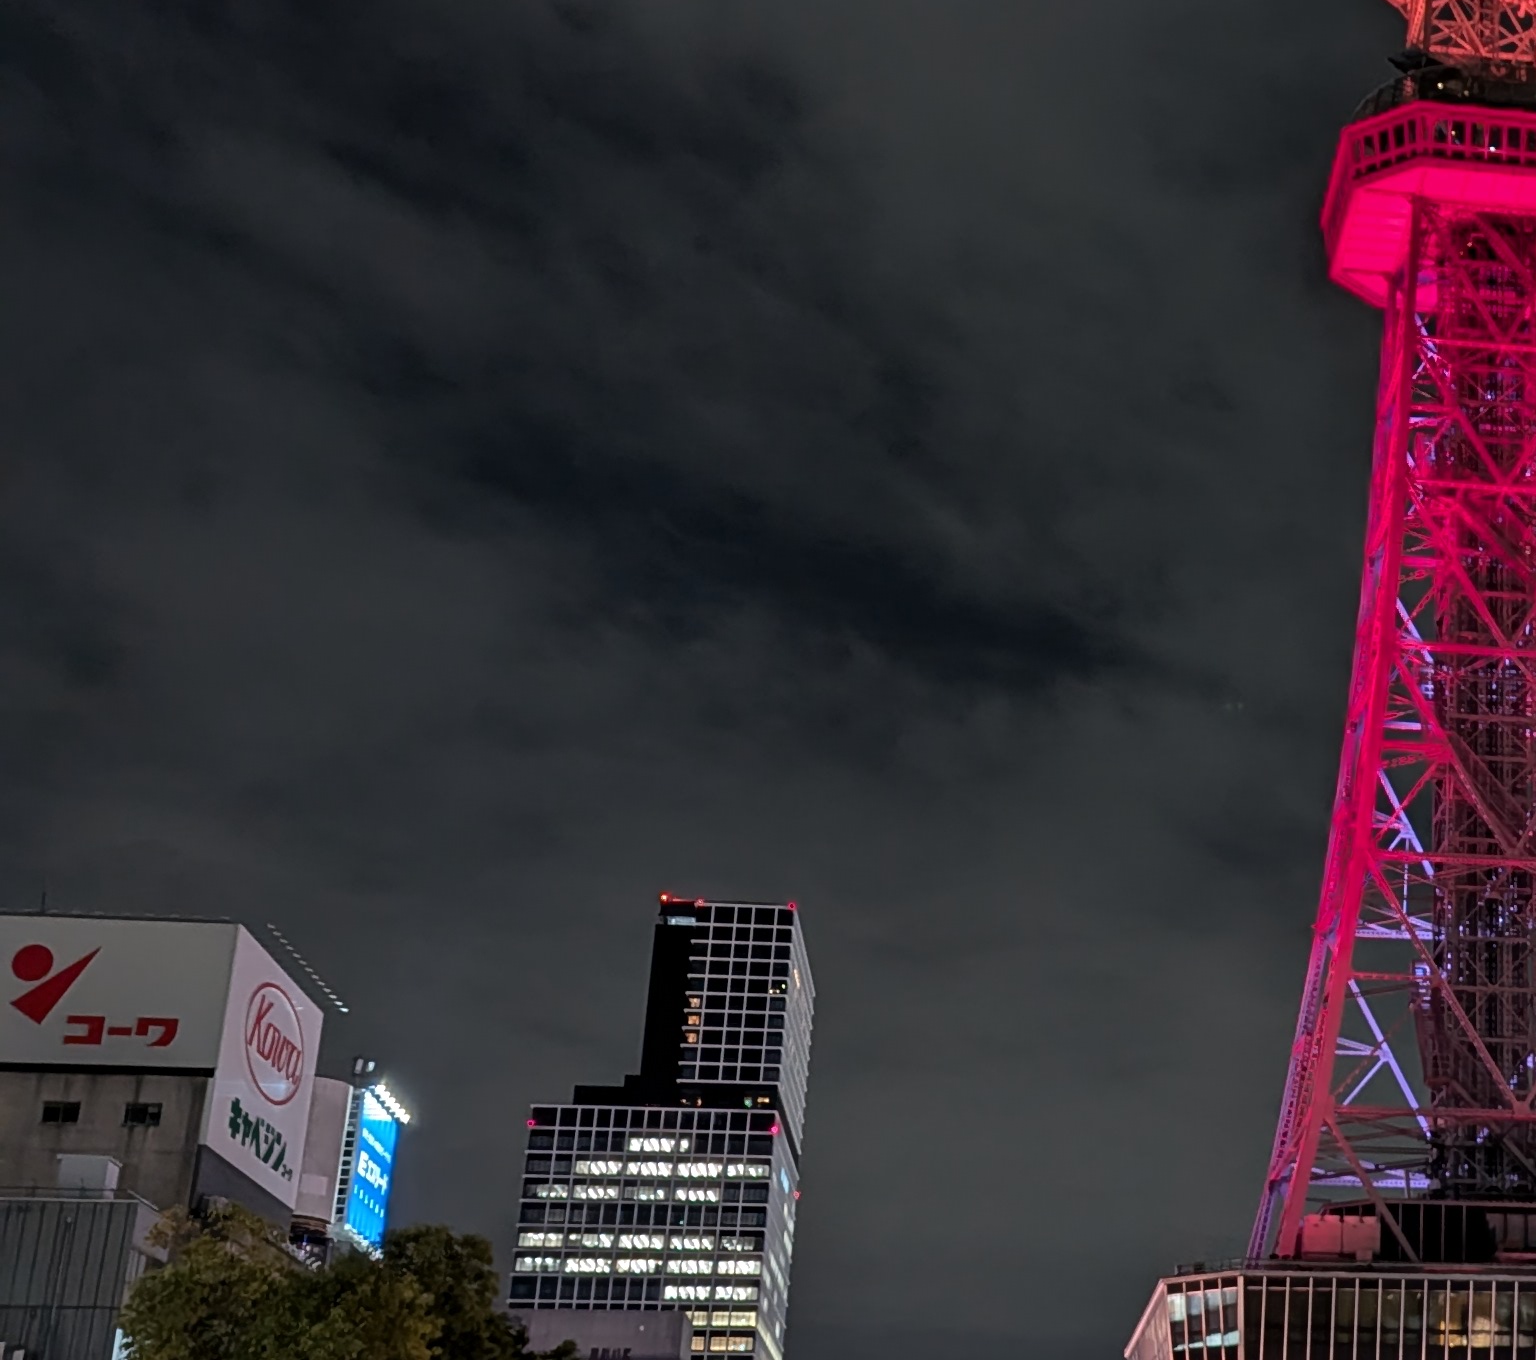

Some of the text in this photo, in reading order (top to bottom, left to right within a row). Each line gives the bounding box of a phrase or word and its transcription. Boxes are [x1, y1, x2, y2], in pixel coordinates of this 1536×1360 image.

[63, 1015, 179, 1048] コーワ
[229, 1097, 287, 1171] キャベジン
